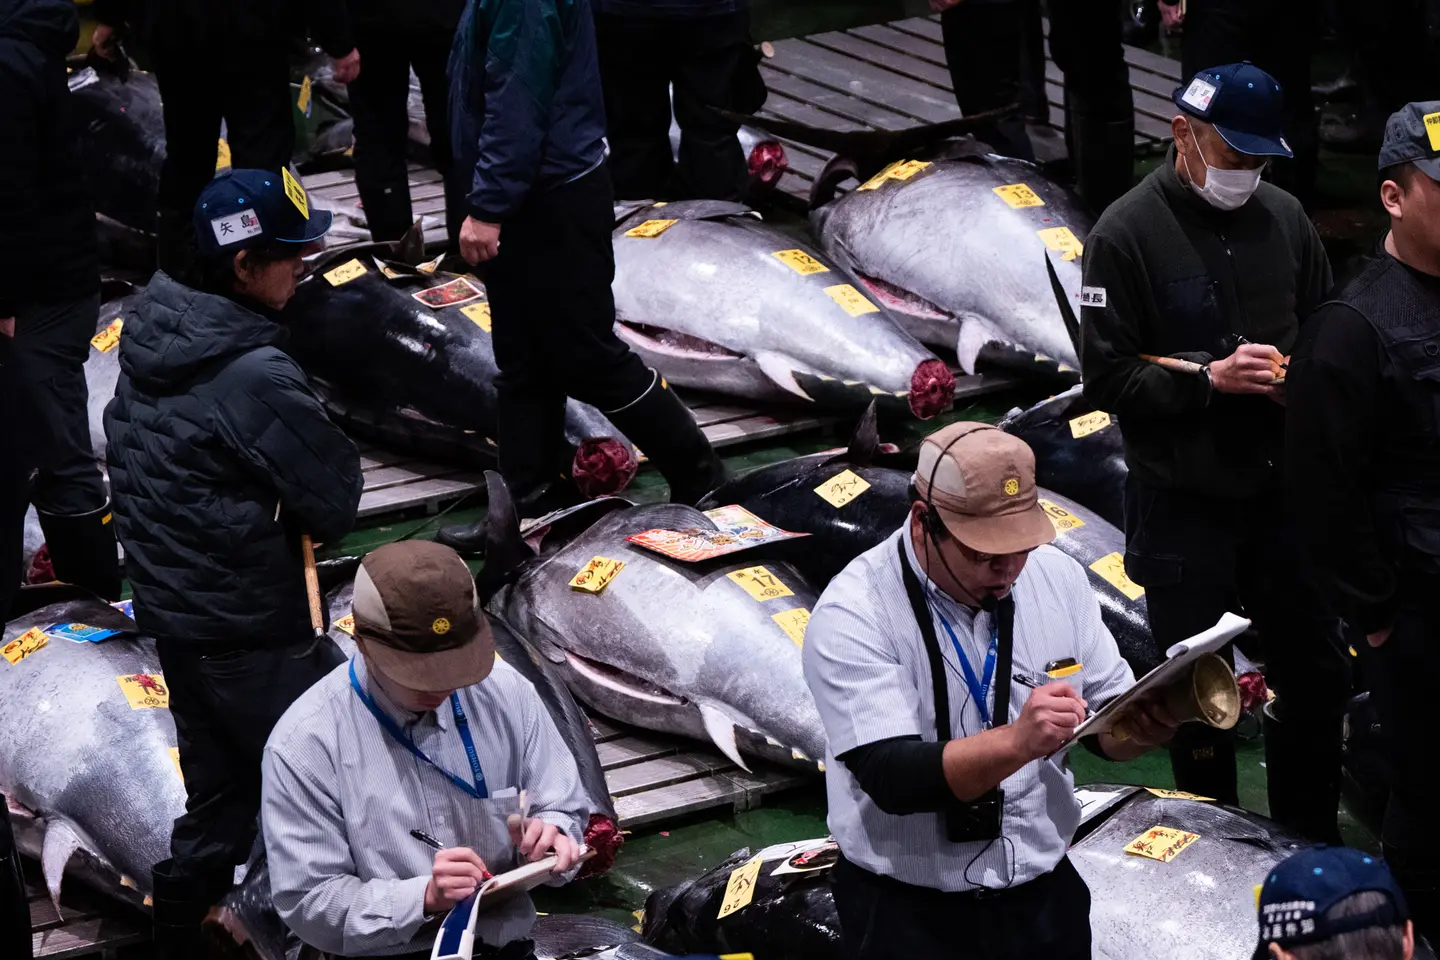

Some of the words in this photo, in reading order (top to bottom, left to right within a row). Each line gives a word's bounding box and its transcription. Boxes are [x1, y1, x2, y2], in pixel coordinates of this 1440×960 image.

[1012, 189, 1034, 199] 13
[220, 214, 251, 236] 矢島
[793, 255, 817, 265] 12
[752, 574, 776, 587] 17
